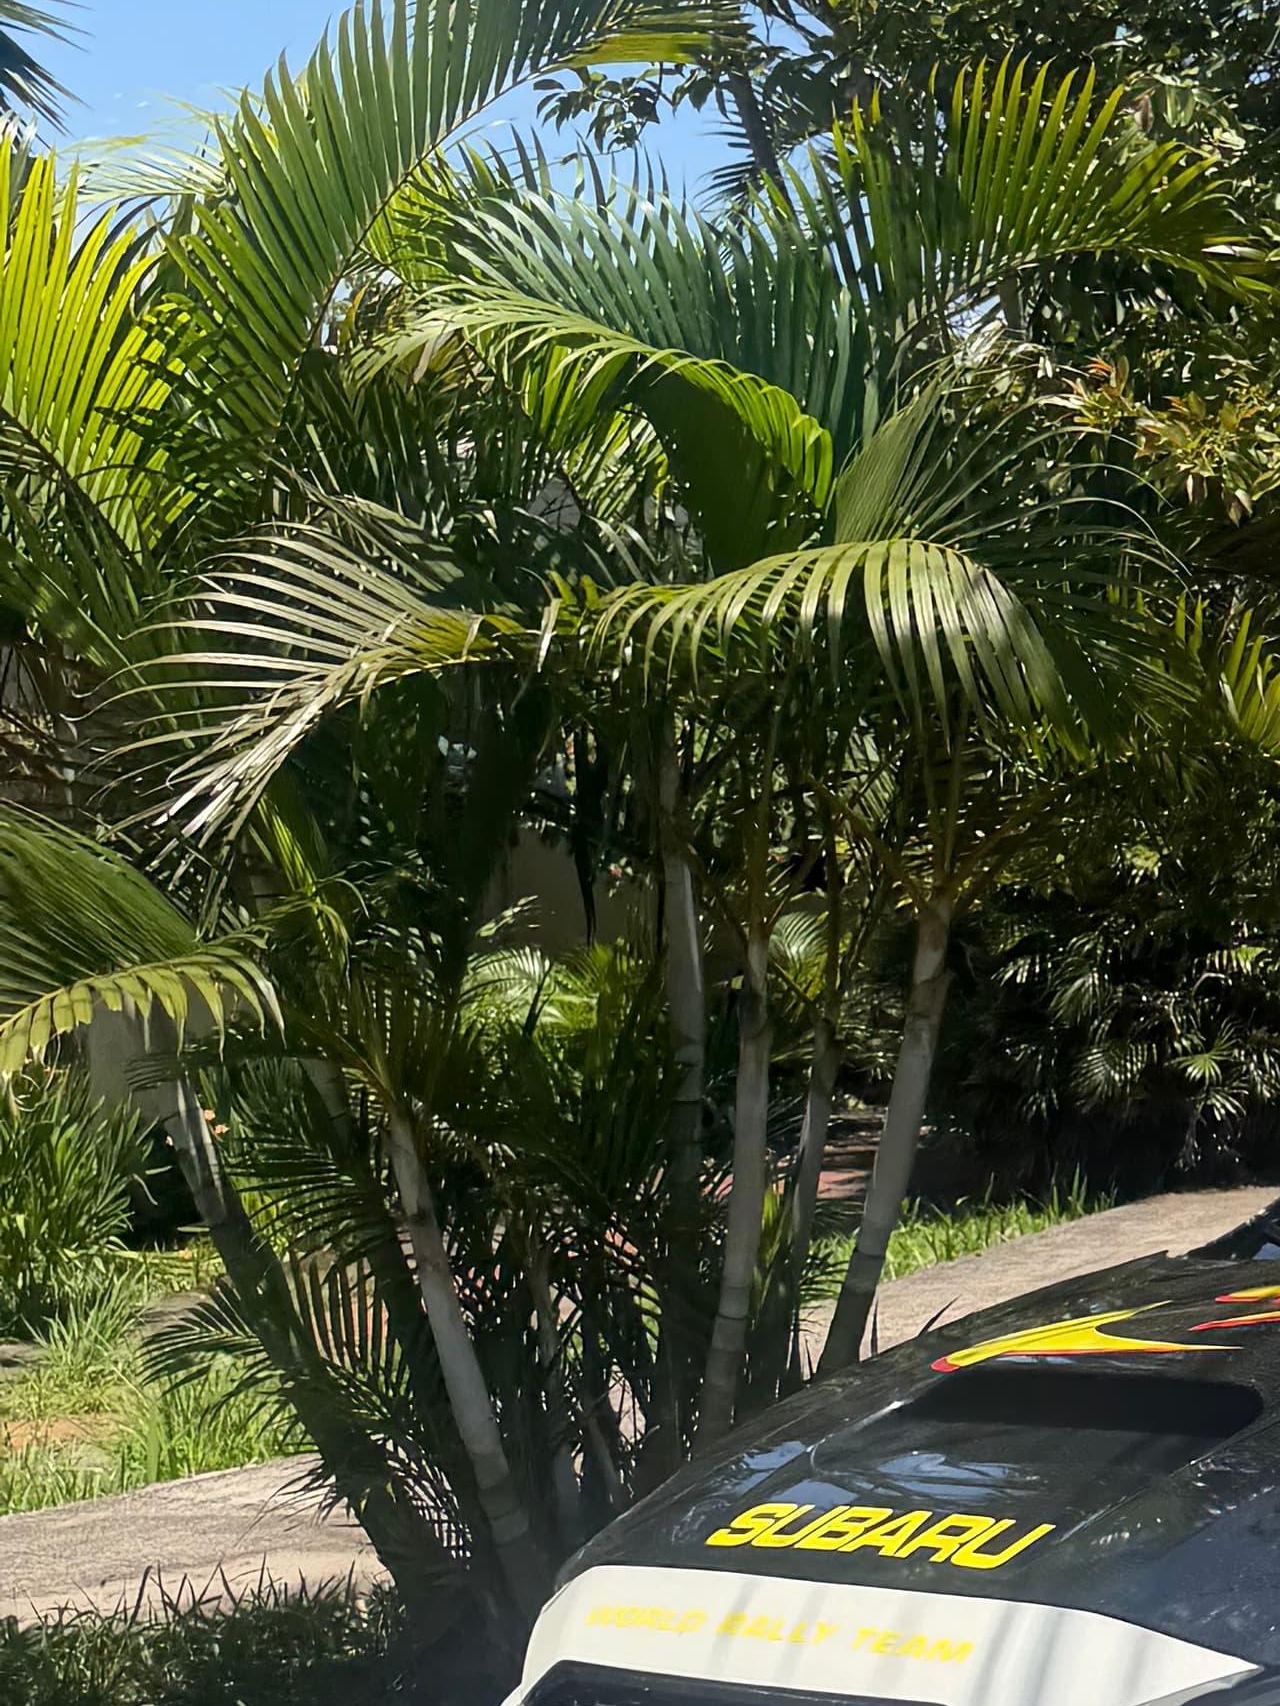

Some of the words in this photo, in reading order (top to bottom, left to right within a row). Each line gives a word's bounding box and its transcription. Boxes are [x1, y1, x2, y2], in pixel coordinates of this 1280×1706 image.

[704, 1502, 1056, 1570] SUBARU
[586, 1606, 706, 1634] WORLD
[716, 1612, 840, 1646] RALLY
[851, 1628, 976, 1664] TEAM
